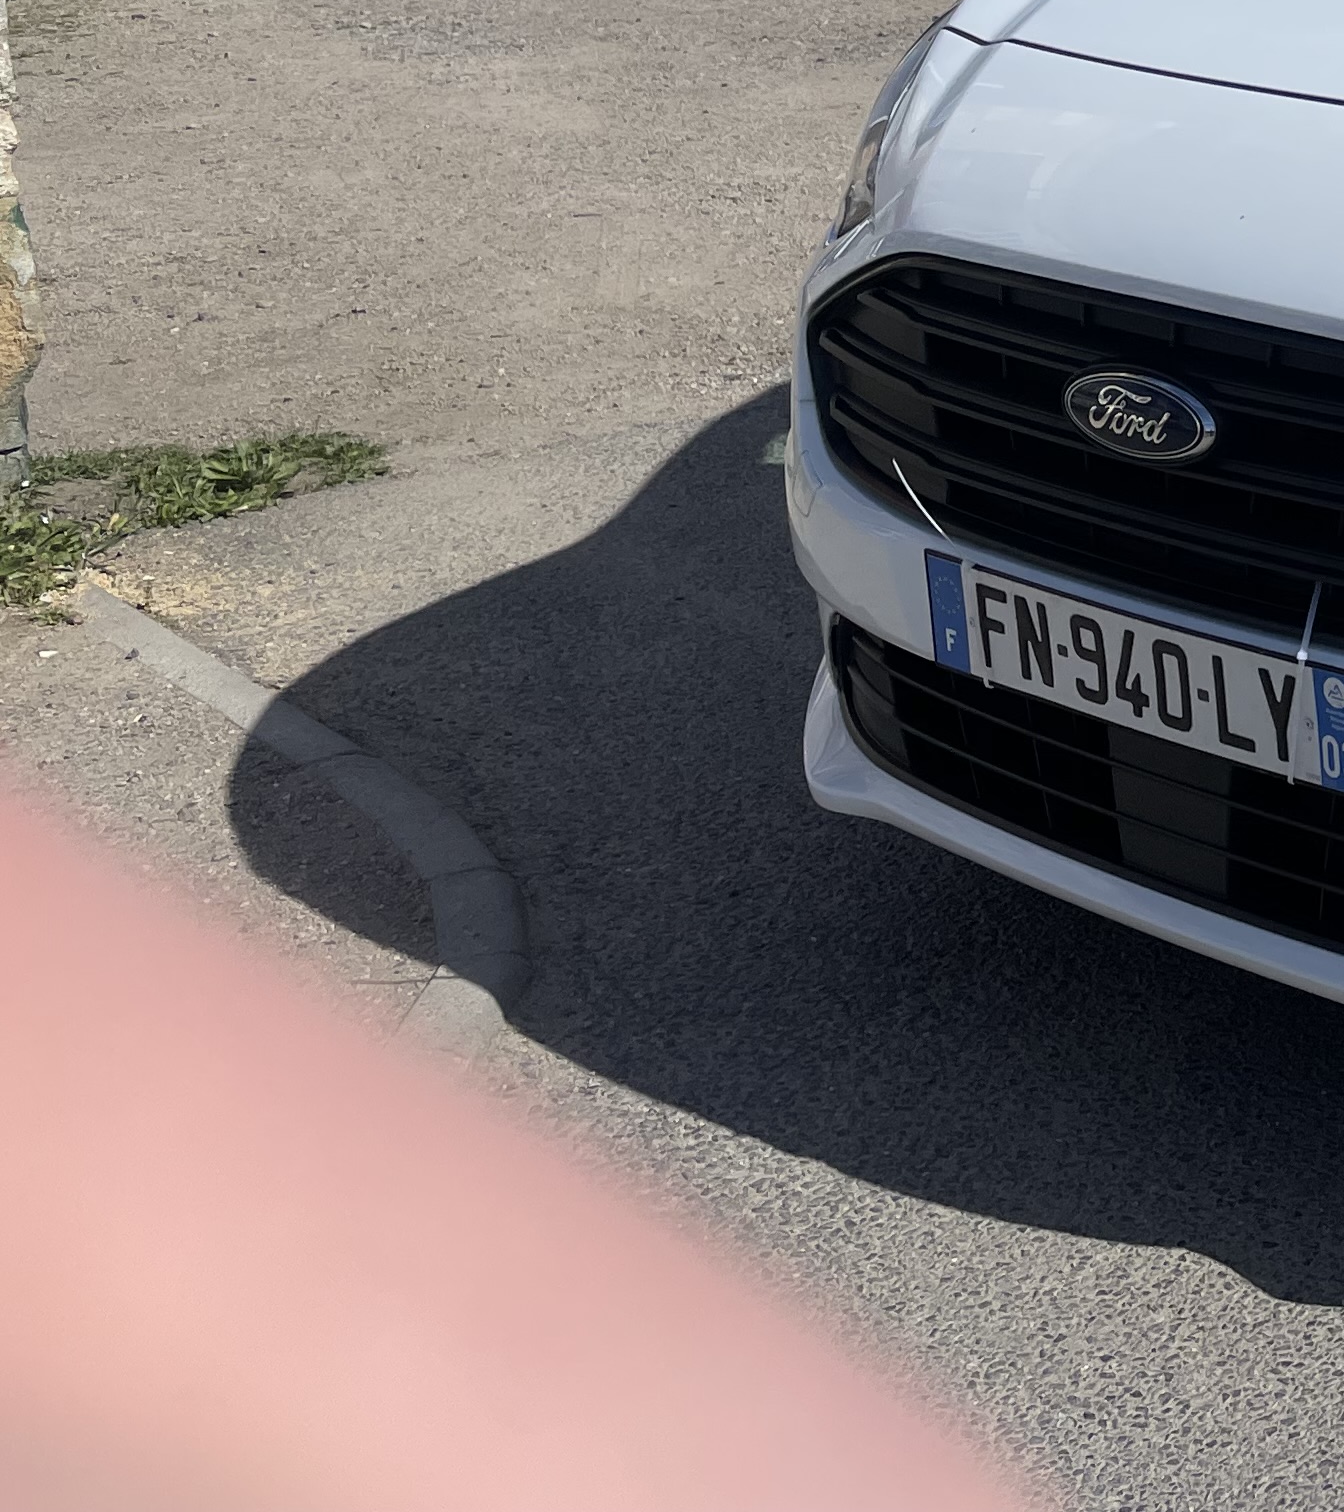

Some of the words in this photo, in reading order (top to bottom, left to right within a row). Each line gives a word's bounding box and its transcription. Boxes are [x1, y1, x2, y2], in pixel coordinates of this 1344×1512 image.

[1088, 384, 1171, 445] Ford
[944, 626, 957, 652] F
[975, 582, 1297, 763] FN-940-LY
